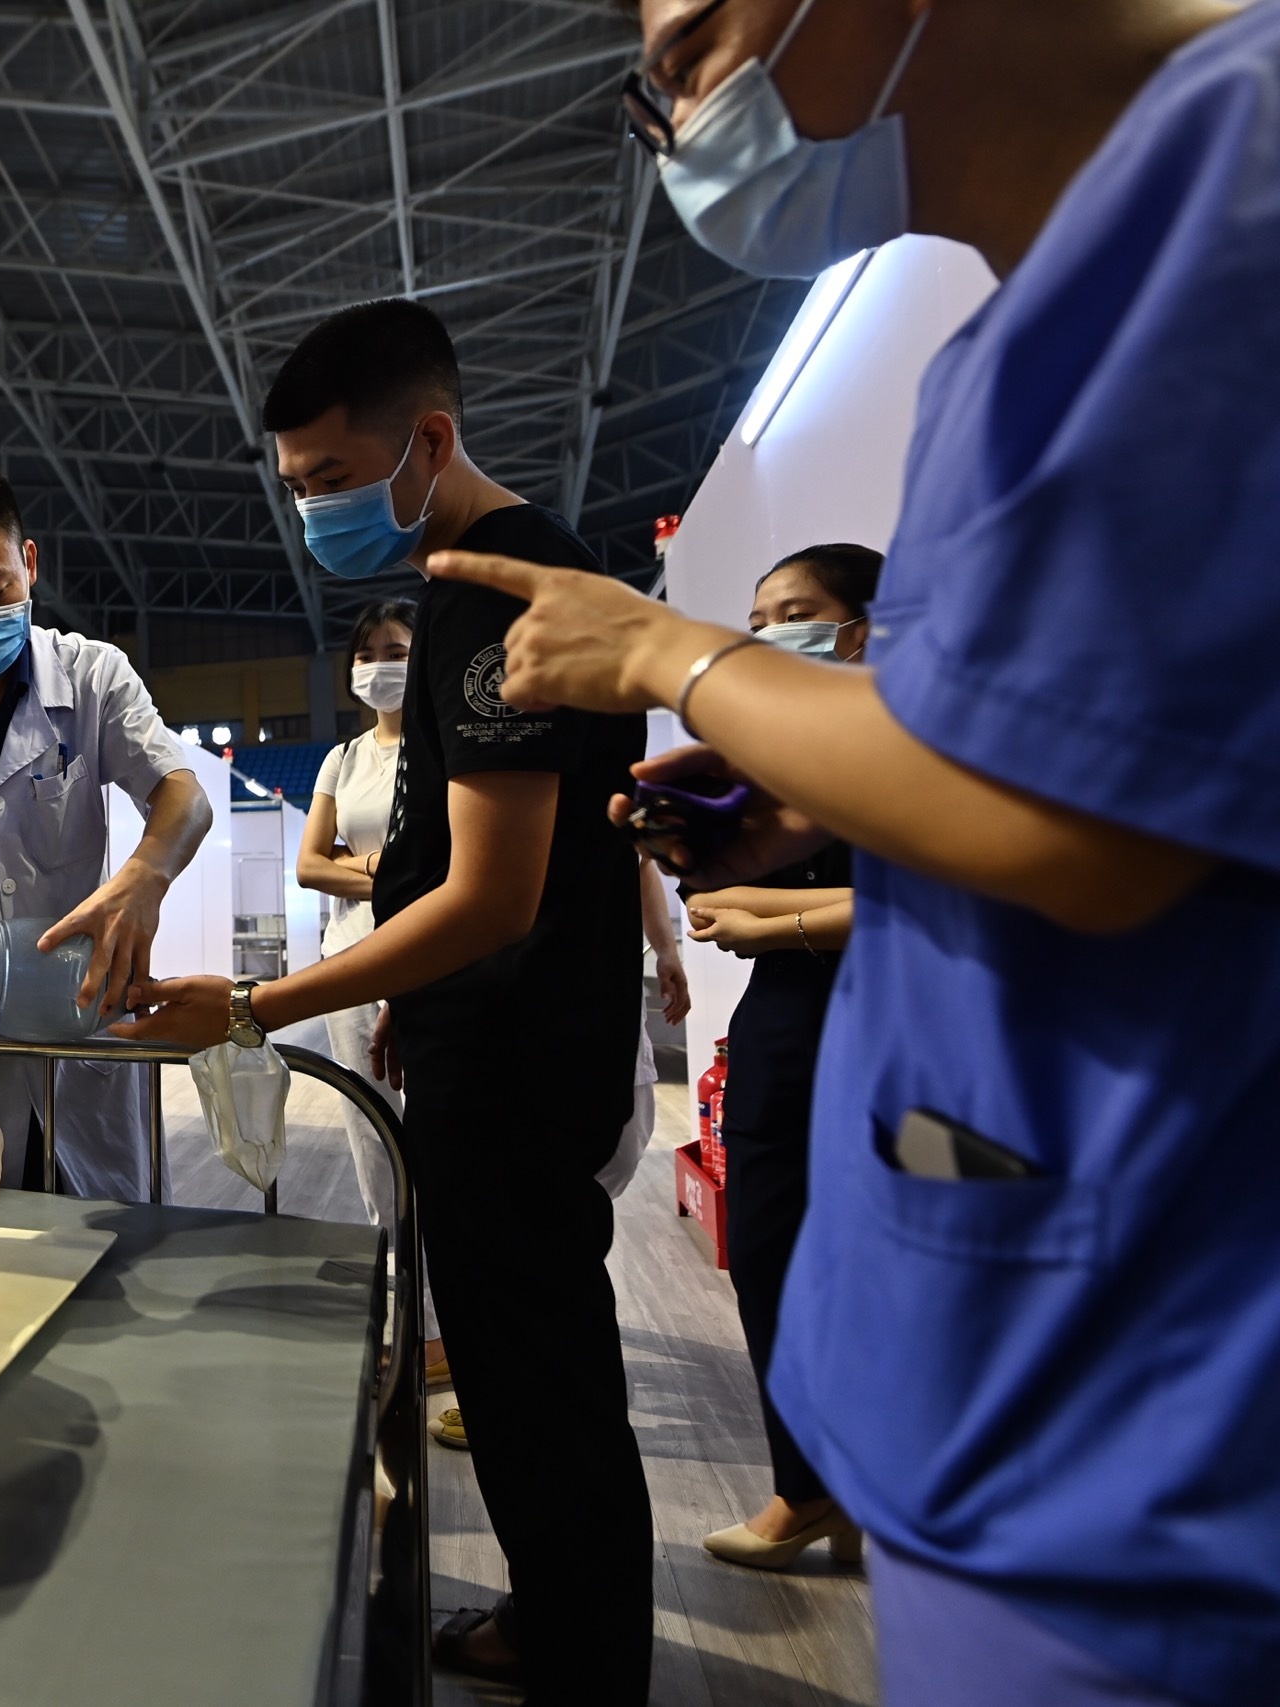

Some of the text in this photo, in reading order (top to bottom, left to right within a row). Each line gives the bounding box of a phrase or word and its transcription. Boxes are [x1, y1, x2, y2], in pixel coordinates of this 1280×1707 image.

[478, 649, 494, 662] Giro
[470, 696, 491, 713] Torino
[474, 722, 488, 730] ON
[489, 721, 504, 729] THE
[505, 721, 532, 729] KAPPA
[534, 721, 553, 730] SIDE
[462, 728, 543, 738] GENUINE PRODUCTS
[477, 736, 501, 744] SINCE
